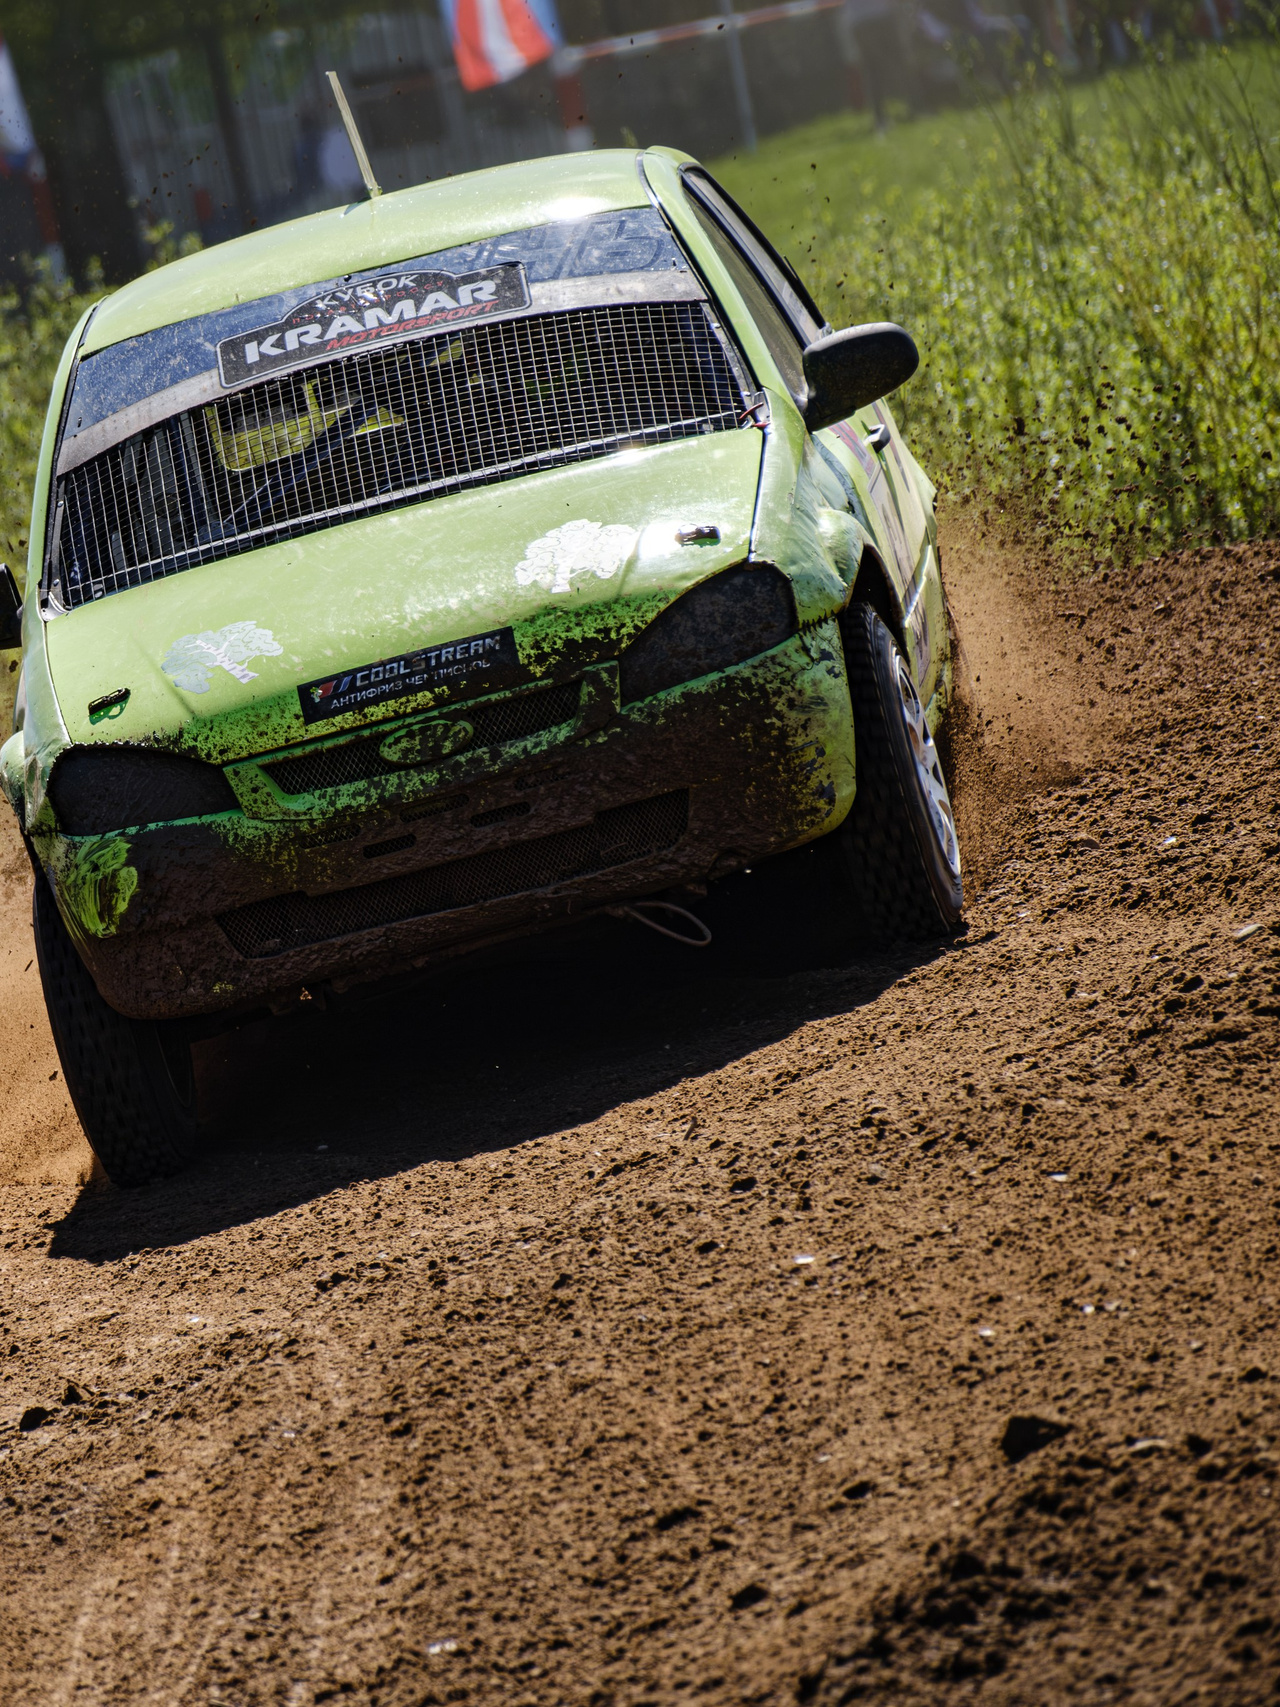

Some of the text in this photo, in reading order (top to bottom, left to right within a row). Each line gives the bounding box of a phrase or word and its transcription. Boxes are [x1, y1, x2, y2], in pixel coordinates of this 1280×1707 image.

[315, 273, 420, 309] КУБОК
[244, 279, 500, 365] KRAMAR
[325, 300, 500, 351] MOTORSPORT
[356, 636, 500, 686] COOLSTREAM
[331, 680, 404, 710] АНТИФРИЗ
